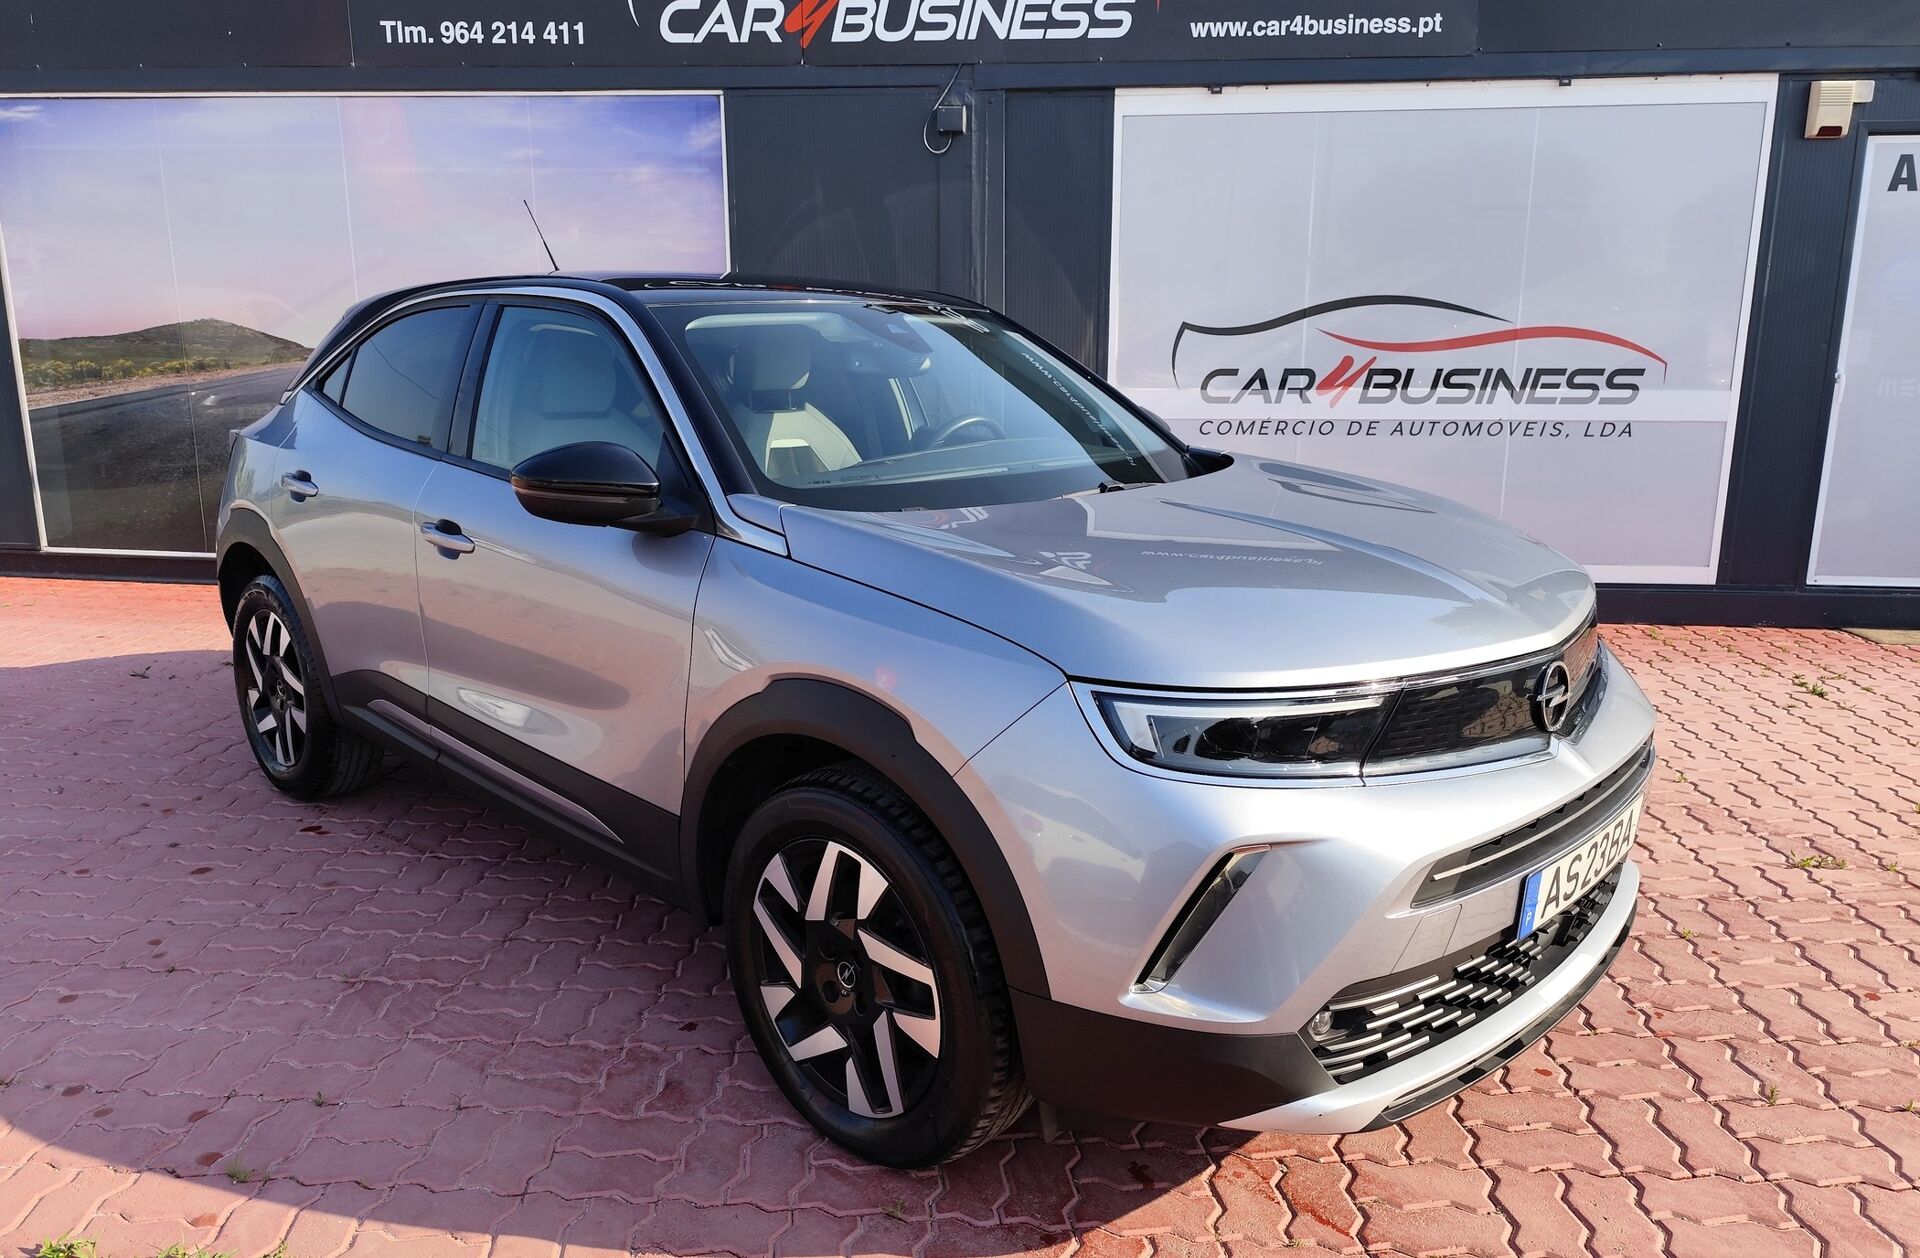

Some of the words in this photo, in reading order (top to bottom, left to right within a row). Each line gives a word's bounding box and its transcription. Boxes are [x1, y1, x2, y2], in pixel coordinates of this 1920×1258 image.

[380, 20, 434, 44] Tlm.
[440, 21, 484, 45] 964
[491, 21, 536, 45] 214
[543, 21, 585, 45] 411
[1190, 13, 1443, 38] www.car4business.pt
[1199, 417, 1334, 437] COMÉRCIO
[1347, 420, 1378, 437] DE
[1390, 418, 1571, 440] AUTOMÓVEIS,
[1584, 421, 1634, 439] LDA
